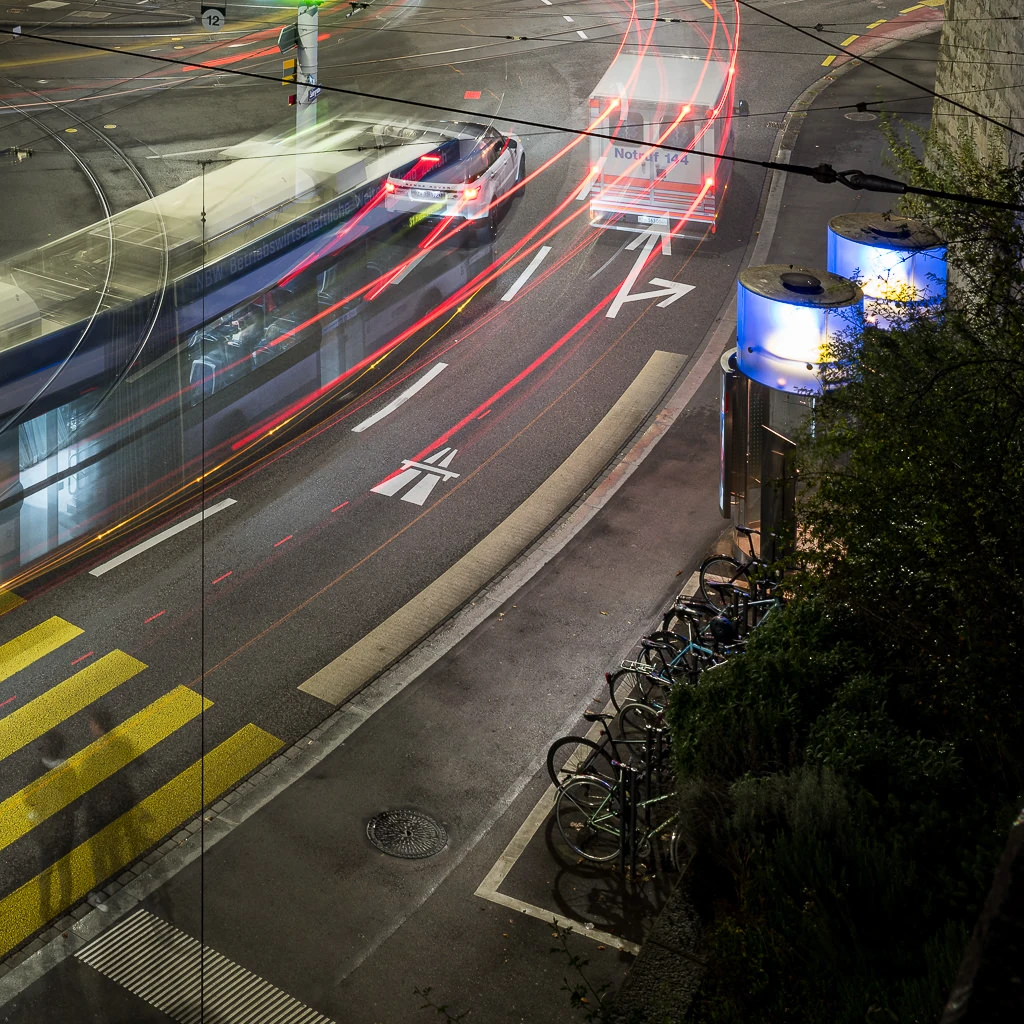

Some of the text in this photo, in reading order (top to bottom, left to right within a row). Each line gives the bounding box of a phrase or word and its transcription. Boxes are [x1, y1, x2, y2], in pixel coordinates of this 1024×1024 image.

[207, 15, 220, 27] 12
[614, 147, 690, 166] Notruf 144
